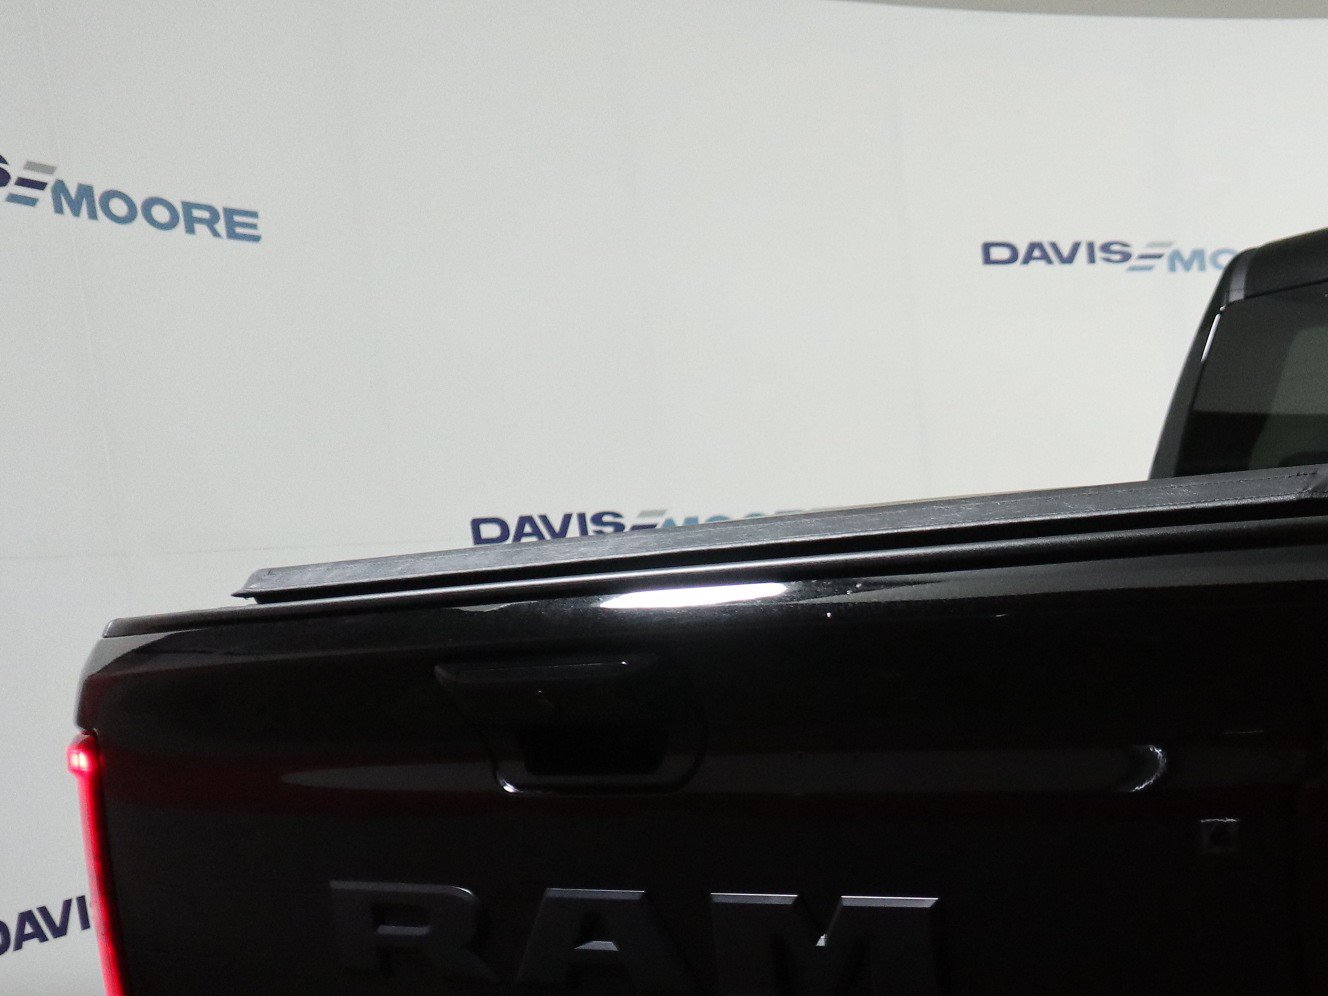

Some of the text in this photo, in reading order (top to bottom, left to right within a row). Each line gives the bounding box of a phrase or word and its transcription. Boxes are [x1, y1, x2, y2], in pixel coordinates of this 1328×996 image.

[51, 178, 261, 242] MOORE
[981, 241, 1132, 265] DAVIS
[471, 511, 625, 545] DAVIS
